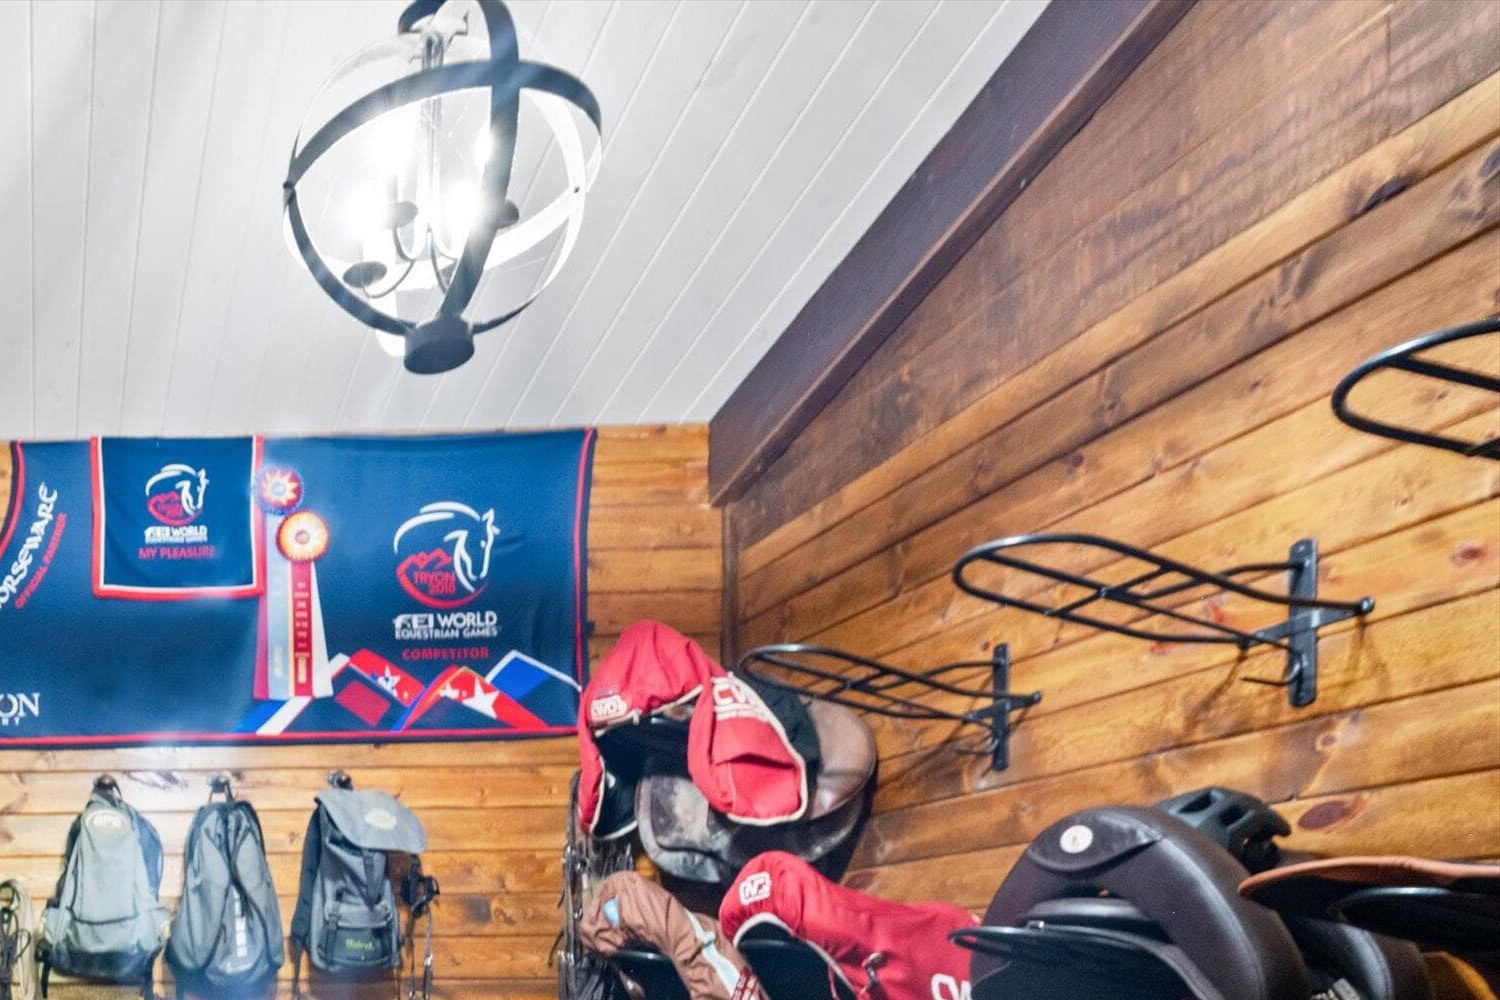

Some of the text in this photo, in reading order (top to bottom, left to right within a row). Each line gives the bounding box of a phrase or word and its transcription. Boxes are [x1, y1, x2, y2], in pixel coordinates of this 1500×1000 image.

[139, 547, 156, 560] MY
[436, 611, 498, 628] WORLD
[395, 625, 498, 640] EQUESTRIAN GAMES
[402, 648, 489, 661] COMPETITOR
